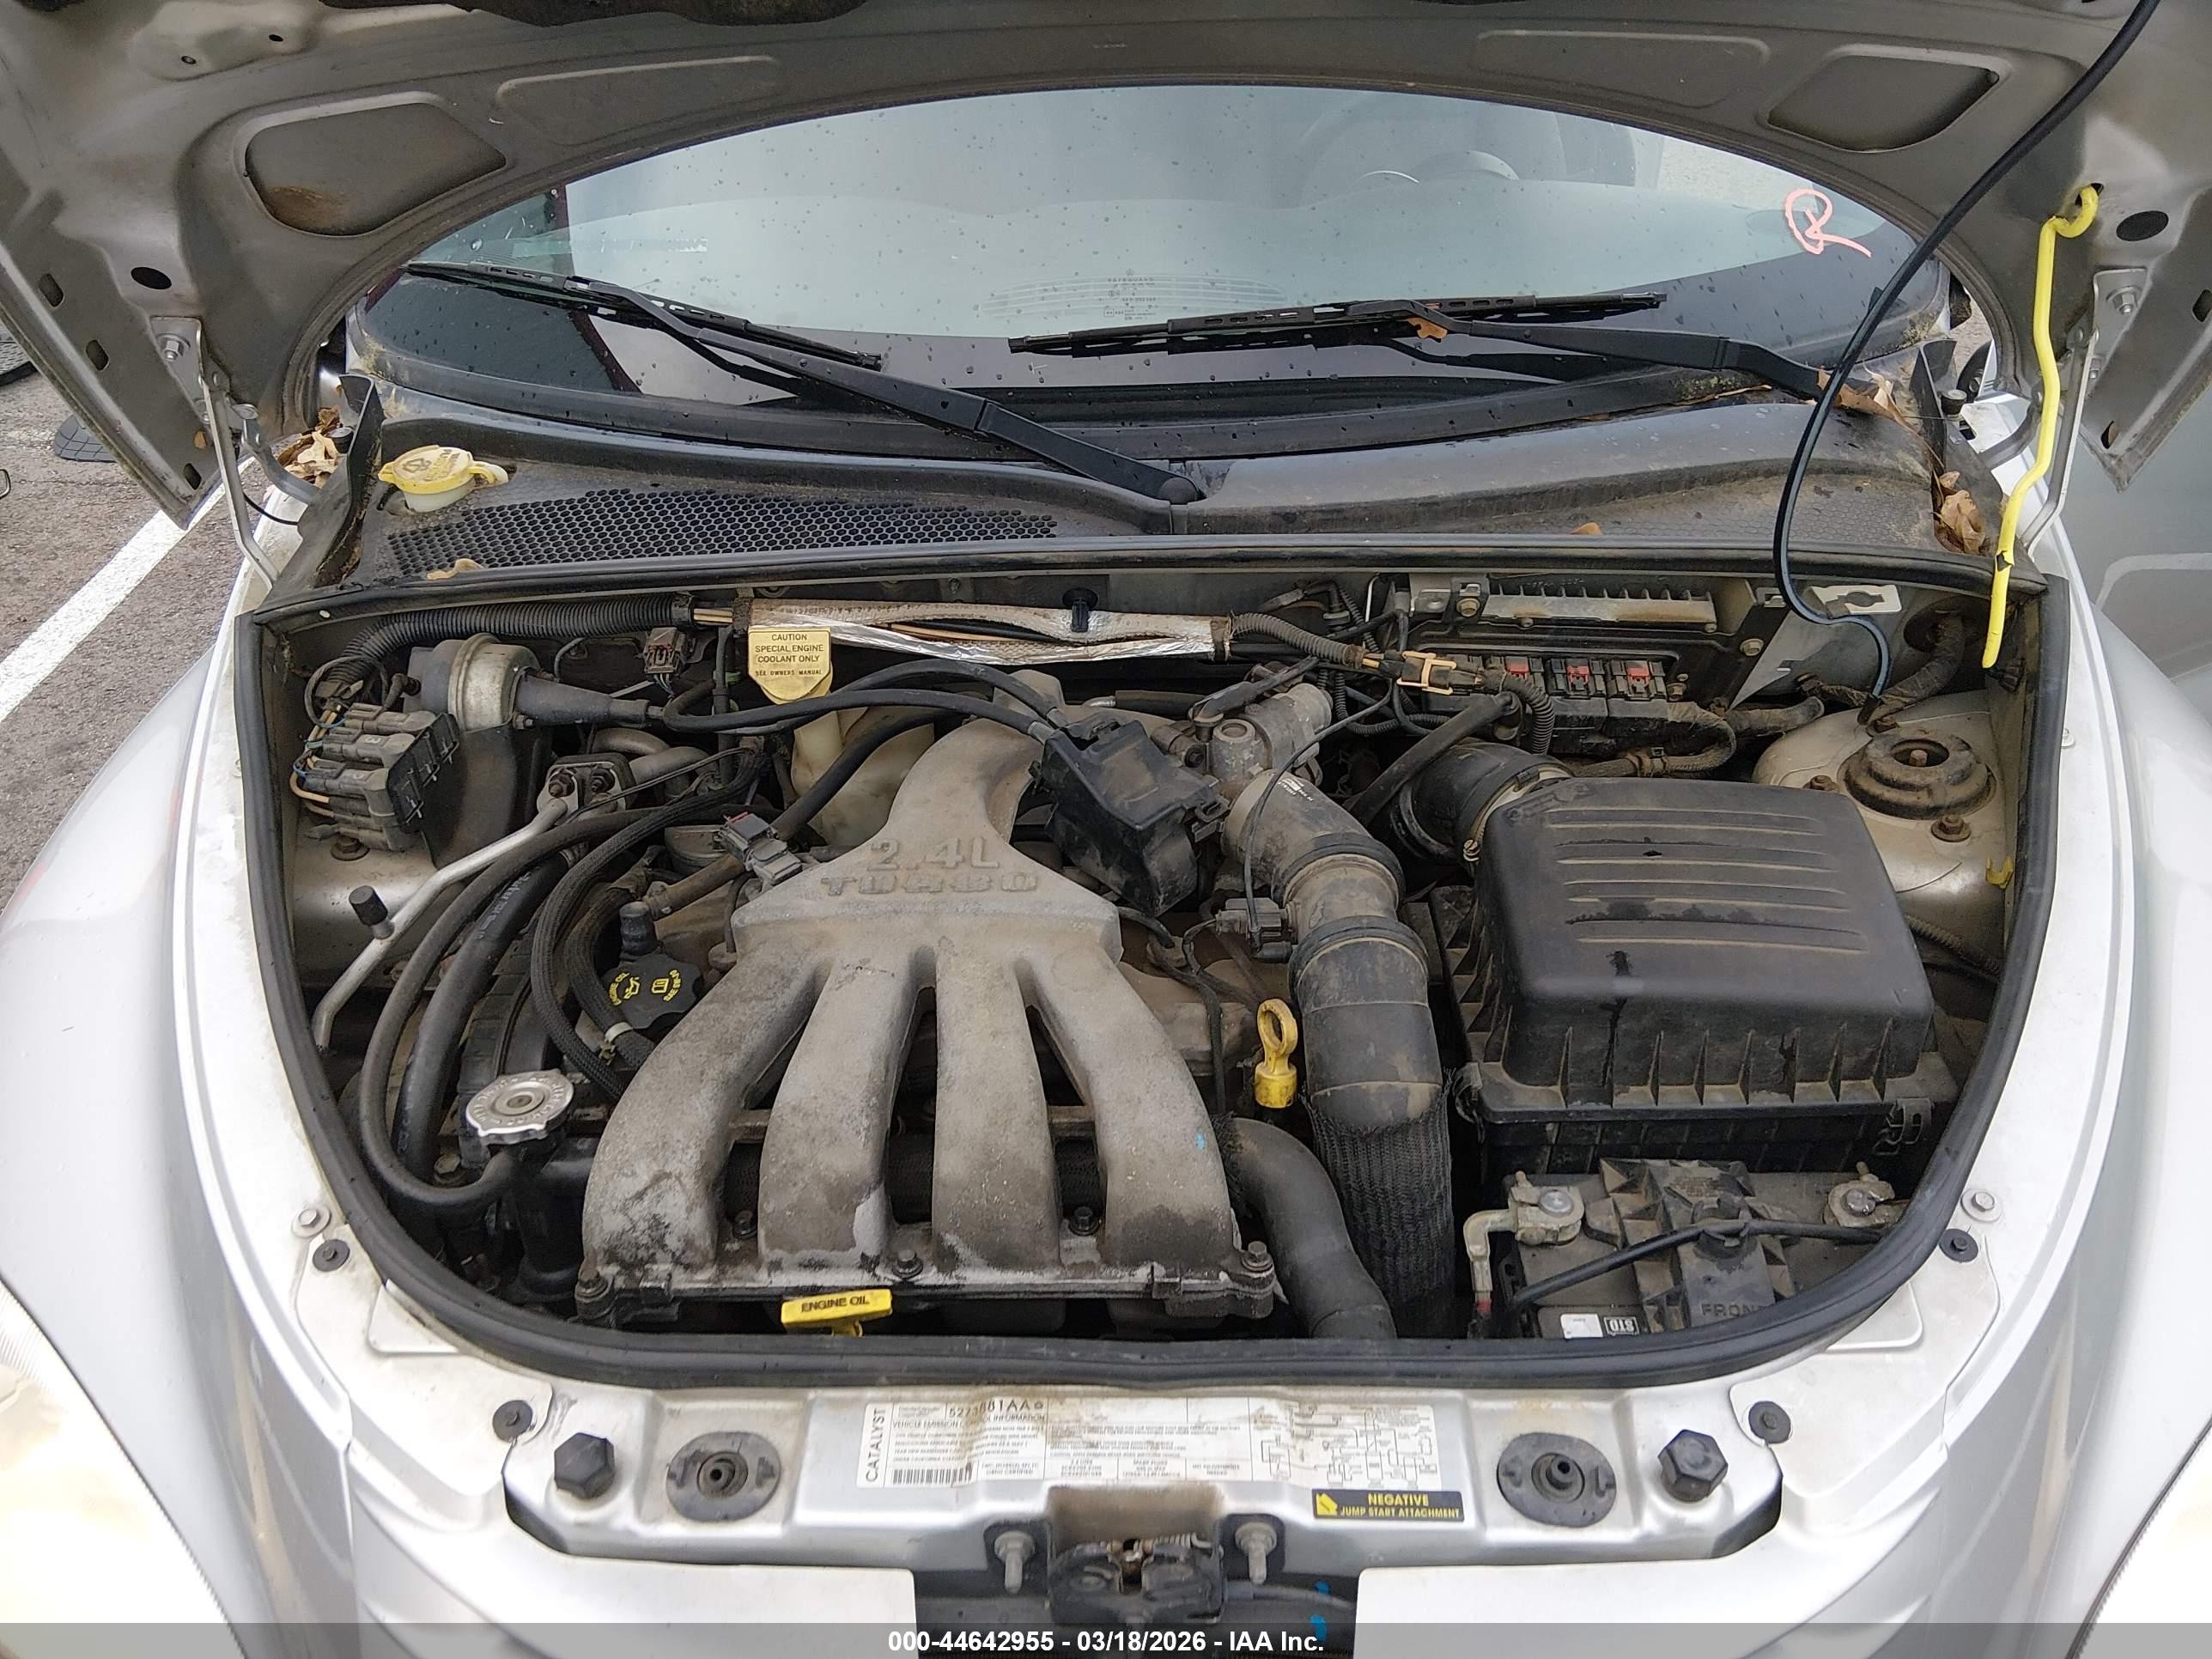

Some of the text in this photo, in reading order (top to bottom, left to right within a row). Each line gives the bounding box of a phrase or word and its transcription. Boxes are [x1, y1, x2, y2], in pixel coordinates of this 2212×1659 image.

[792, 644, 824, 653] ENGINE
[757, 654, 821, 664] COOLANT ONLY
[866, 836, 1000, 872] 2.4L
[801, 1296, 871, 1312] ENGINE OIL
[865, 1408, 886, 1483] CATALYST
[1367, 1492, 1429, 1506] NEGATIVE
[1340, 1506, 1460, 1519] JUMP START ATTACHMENT
